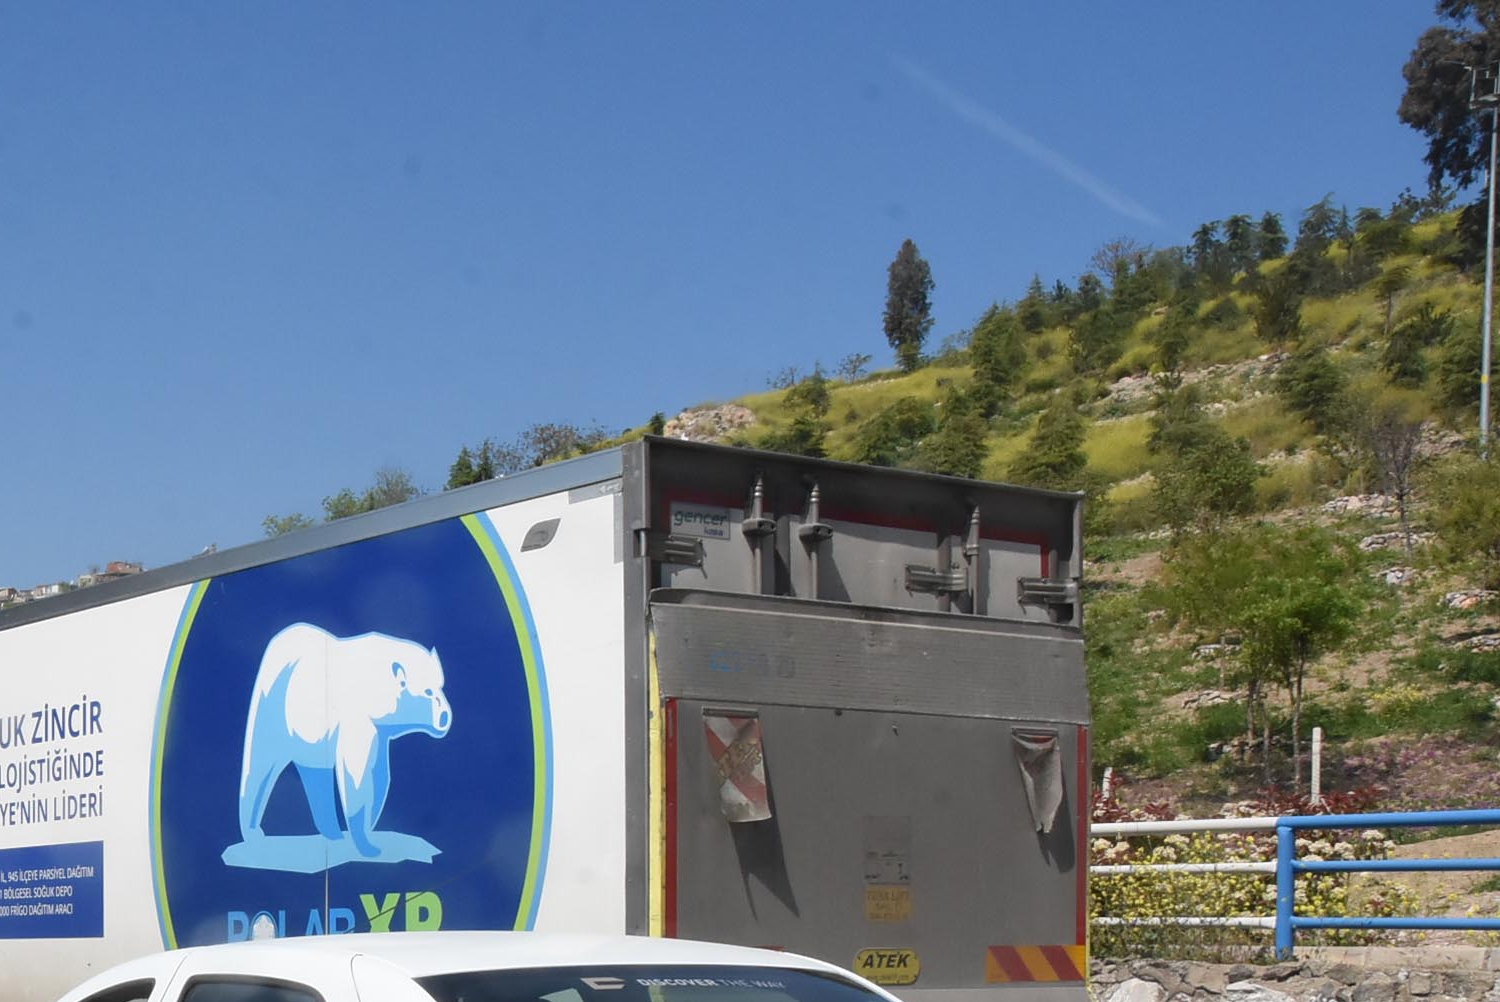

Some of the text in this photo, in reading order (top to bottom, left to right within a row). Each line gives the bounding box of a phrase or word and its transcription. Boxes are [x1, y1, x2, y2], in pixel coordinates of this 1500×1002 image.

[31, 694, 103, 745] ZİNCİR
[53, 785, 103, 821] LİDERİ
[8, 871, 19, 882] 945
[19, 868, 38, 885] İLÇEYE
[39, 866, 66, 880] PARSİYEL
[67, 864, 94, 879] DAĞITIM
[4, 886, 32, 900] BÖLGESEL
[33, 884, 55, 898] SOĞUK
[55, 885, 73, 897] DEPO
[10, 903, 28, 916] FRİGO
[29, 902, 54, 916] DAĞITIM
[55, 903, 73, 914] ARACI
[862, 953, 910, 968] ATEK
[636, 978, 718, 987] DISCOVER
[719, 979, 750, 988] THE
